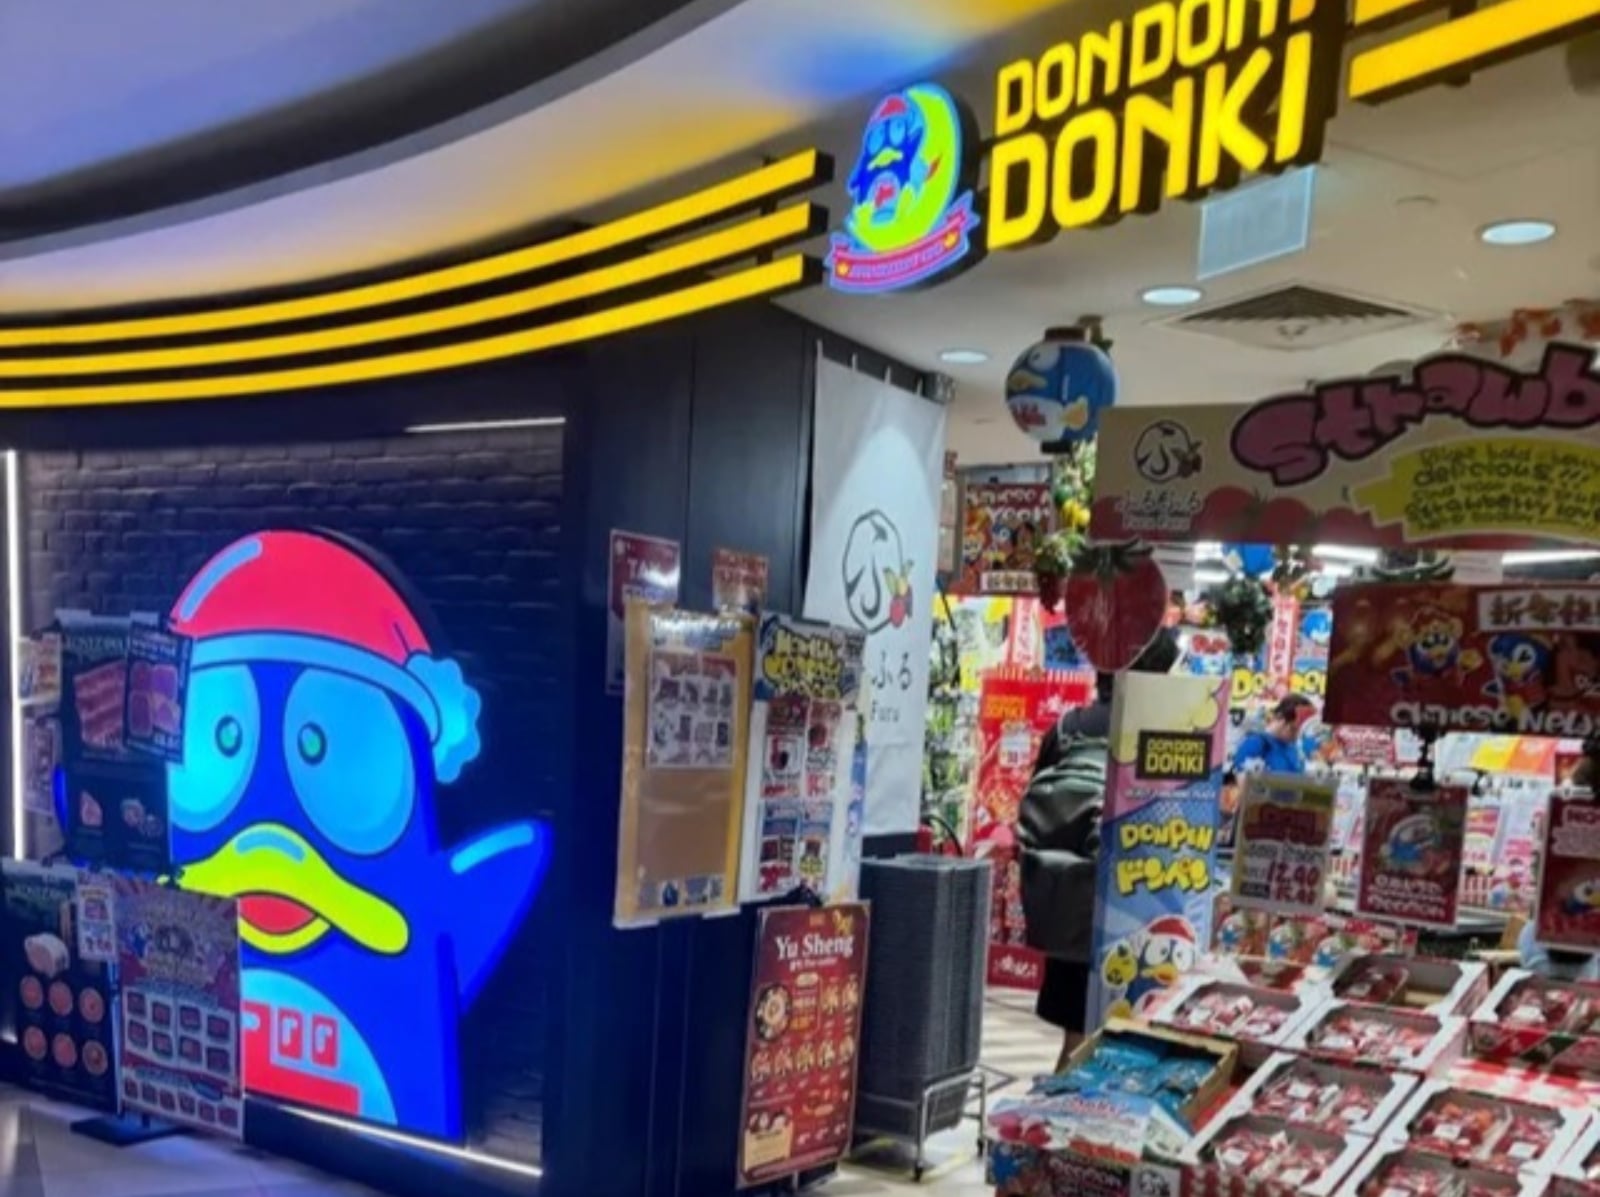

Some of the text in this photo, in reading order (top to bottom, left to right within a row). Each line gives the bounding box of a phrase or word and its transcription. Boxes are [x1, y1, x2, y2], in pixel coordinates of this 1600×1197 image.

[996, 21, 1124, 136] DON
[987, 31, 1312, 249] DONKI
[1145, 754, 1204, 774] DONKI
[775, 932, 855, 960] Yu Sheng
